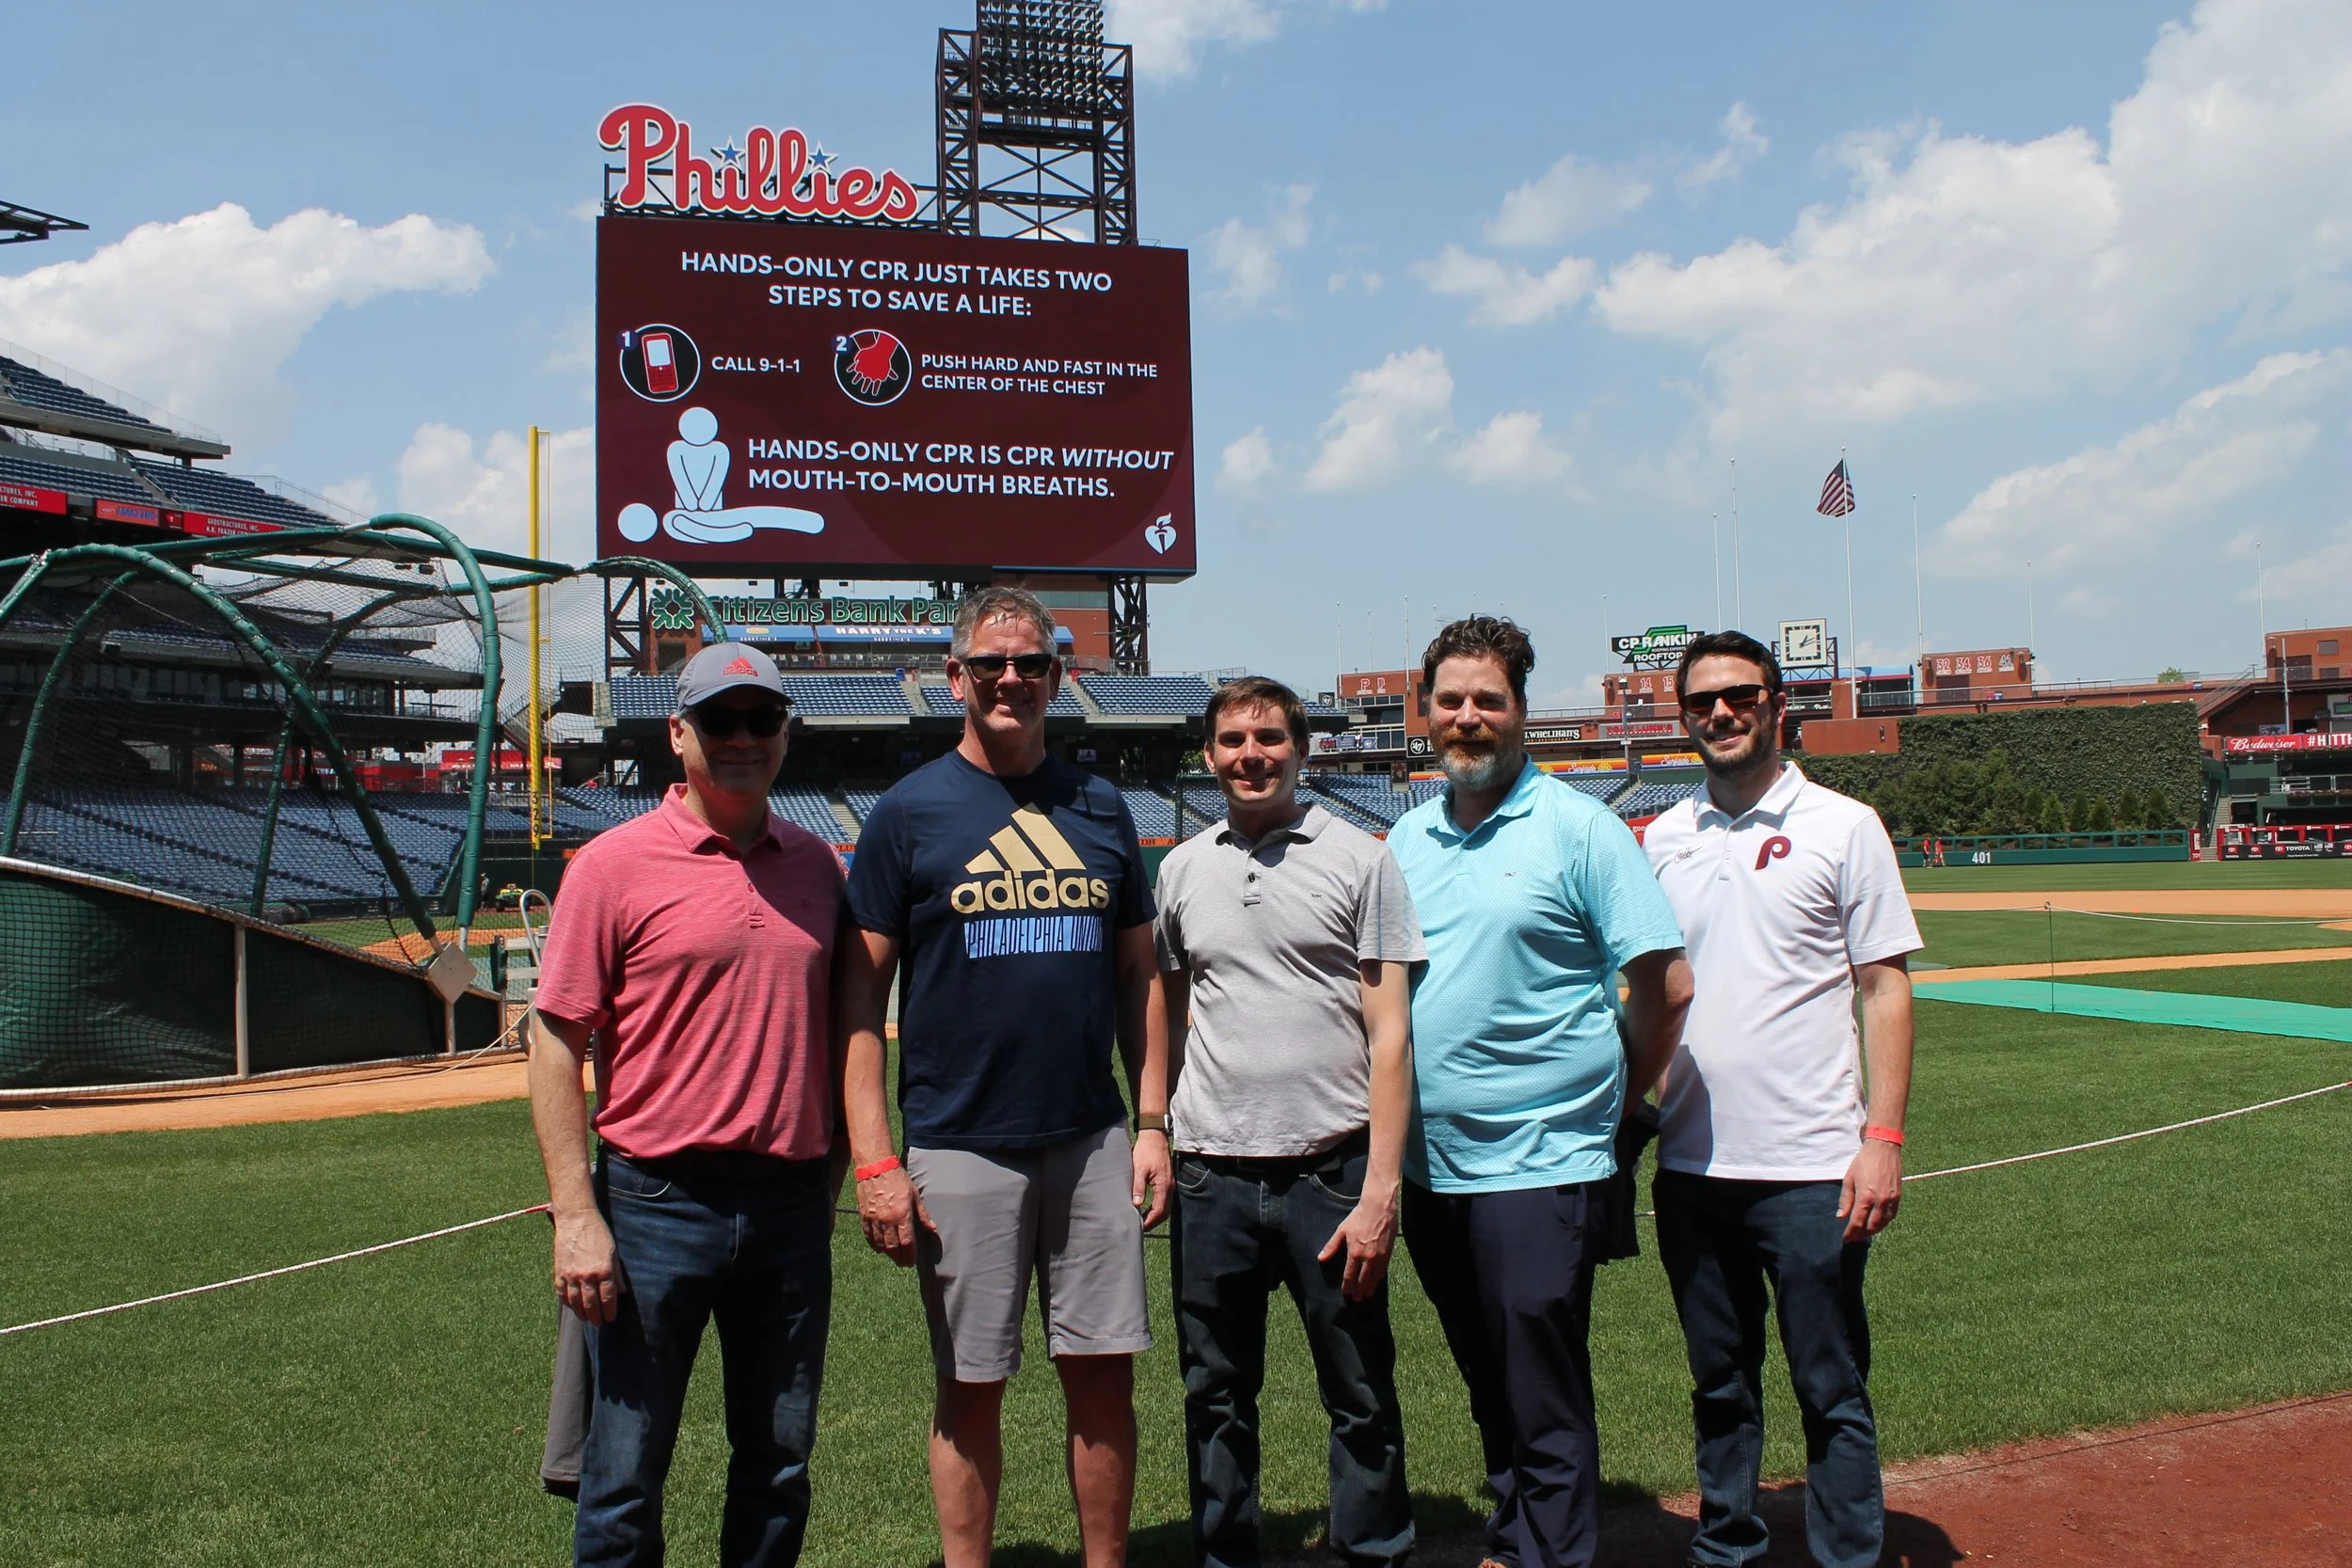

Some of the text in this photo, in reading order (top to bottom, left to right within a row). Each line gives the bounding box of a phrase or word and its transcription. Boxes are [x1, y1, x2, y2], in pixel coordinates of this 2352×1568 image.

[598, 103, 919, 221] Phillies
[681, 251, 1112, 292] HANDS-ONLY CPR JUST TAKES TWO
[769, 284, 1032, 316] STEPS TO SAVE A LIFE:
[621, 330, 631, 347] 1
[835, 335, 848, 352] 2
[711, 356, 801, 373] CALL 9-1-1
[921, 354, 1158, 378] PUSH HARD AND FAST IN THE
[921, 374, 1105, 395] CENTER OF THE CHEST
[748, 438, 1175, 470] HANDS-ONLY CPR IS CPR WITHOUT
[749, 468, 1115, 498] MOUTH-TO-MOUTH BREATHS.
[831, 595, 906, 623] Bank
[912, 597, 959, 624] Par
[834, 626, 891, 636] HARRY
[915, 626, 943, 636] K'S
[1618, 633, 1697, 650] CP RANKIN
[1633, 652, 1683, 662] ROOFTOP
[1640, 676, 1652, 689] 14
[1662, 675, 1675, 688] 15
[2231, 737, 2296, 751] Budweiser
[1755, 835, 1792, 871] P
[1971, 851, 1992, 863] 401
[950, 868, 1110, 914] adidas
